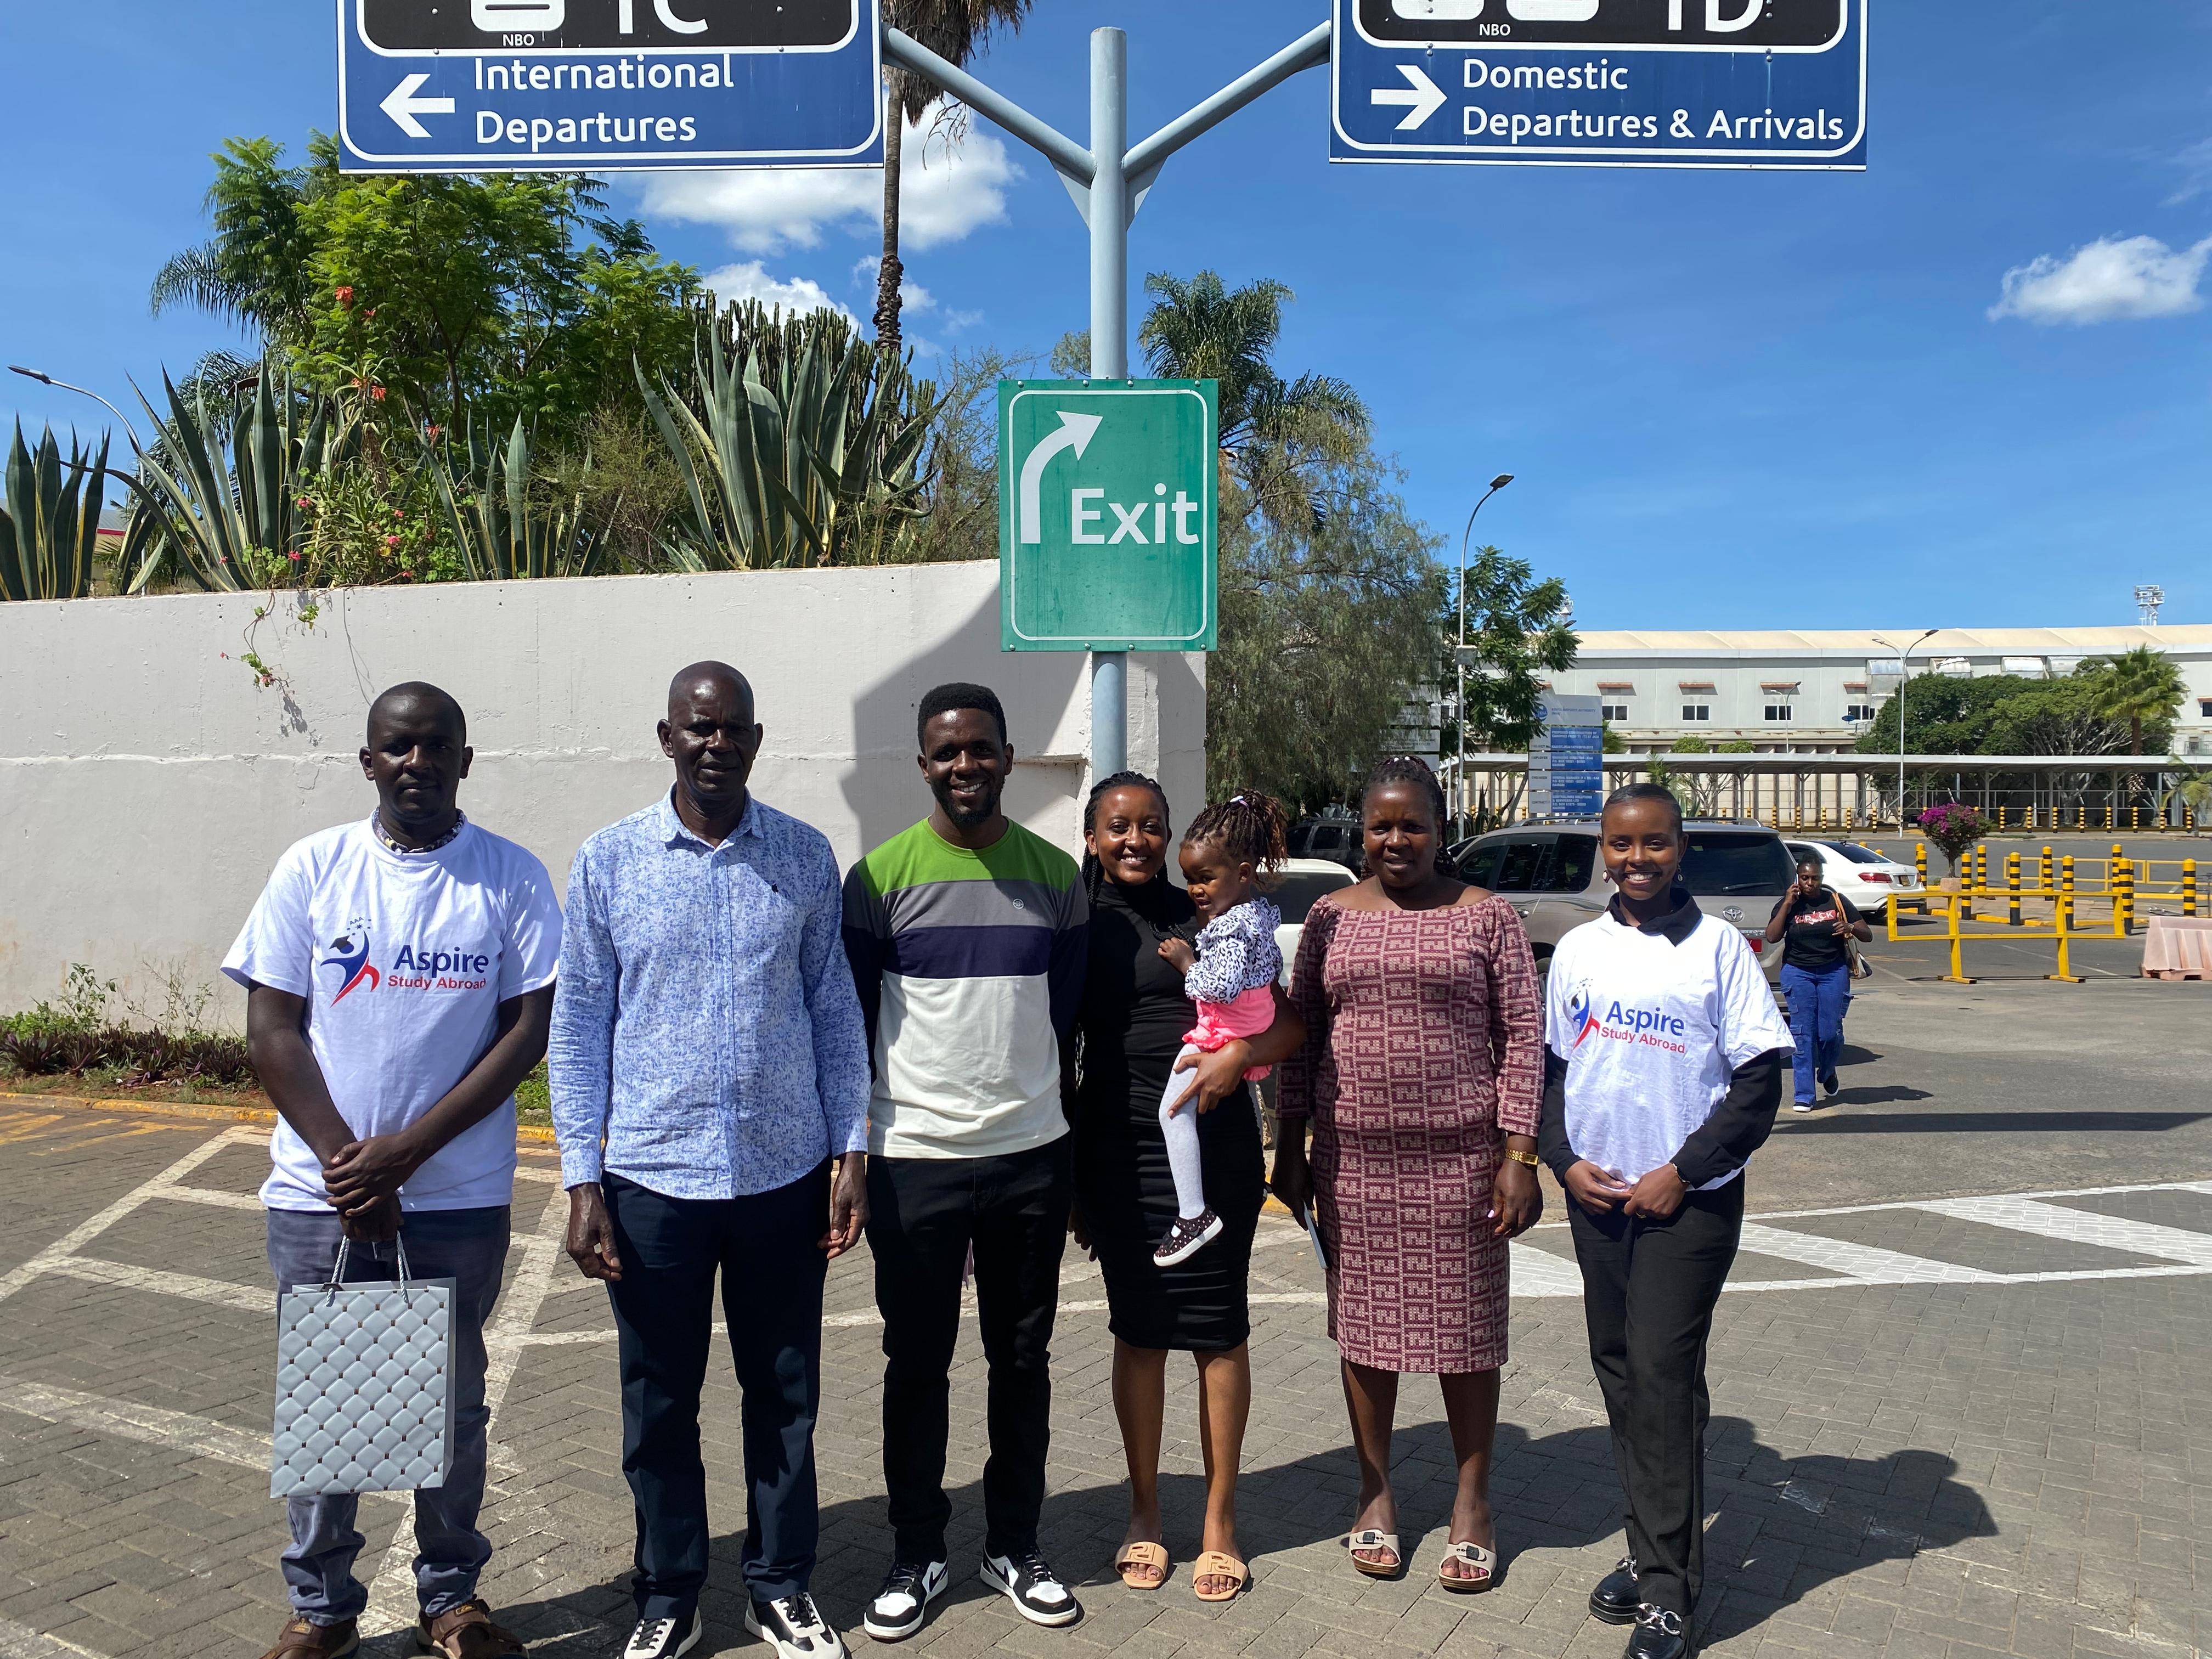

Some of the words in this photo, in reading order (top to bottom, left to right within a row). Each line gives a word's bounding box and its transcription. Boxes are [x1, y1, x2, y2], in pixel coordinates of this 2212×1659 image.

[503, 33, 534, 47] NBO
[1480, 24, 1511, 36] NBO
[476, 54, 734, 90] International
[1464, 58, 1628, 89] Domestic
[476, 110, 696, 153] Departures
[1464, 106, 1658, 144] Departures
[1669, 109, 1696, 138] &
[1706, 109, 1843, 140] Arrivals
[1071, 483, 1199, 544] Exit
[393, 945, 489, 978] Aspire
[387, 974, 432, 990] Study
[436, 977, 486, 989] Abroad
[1605, 1001, 1684, 1036] Aspire
[1601, 1026, 1636, 1043] Study
[1639, 1033, 1685, 1053] Abroad
